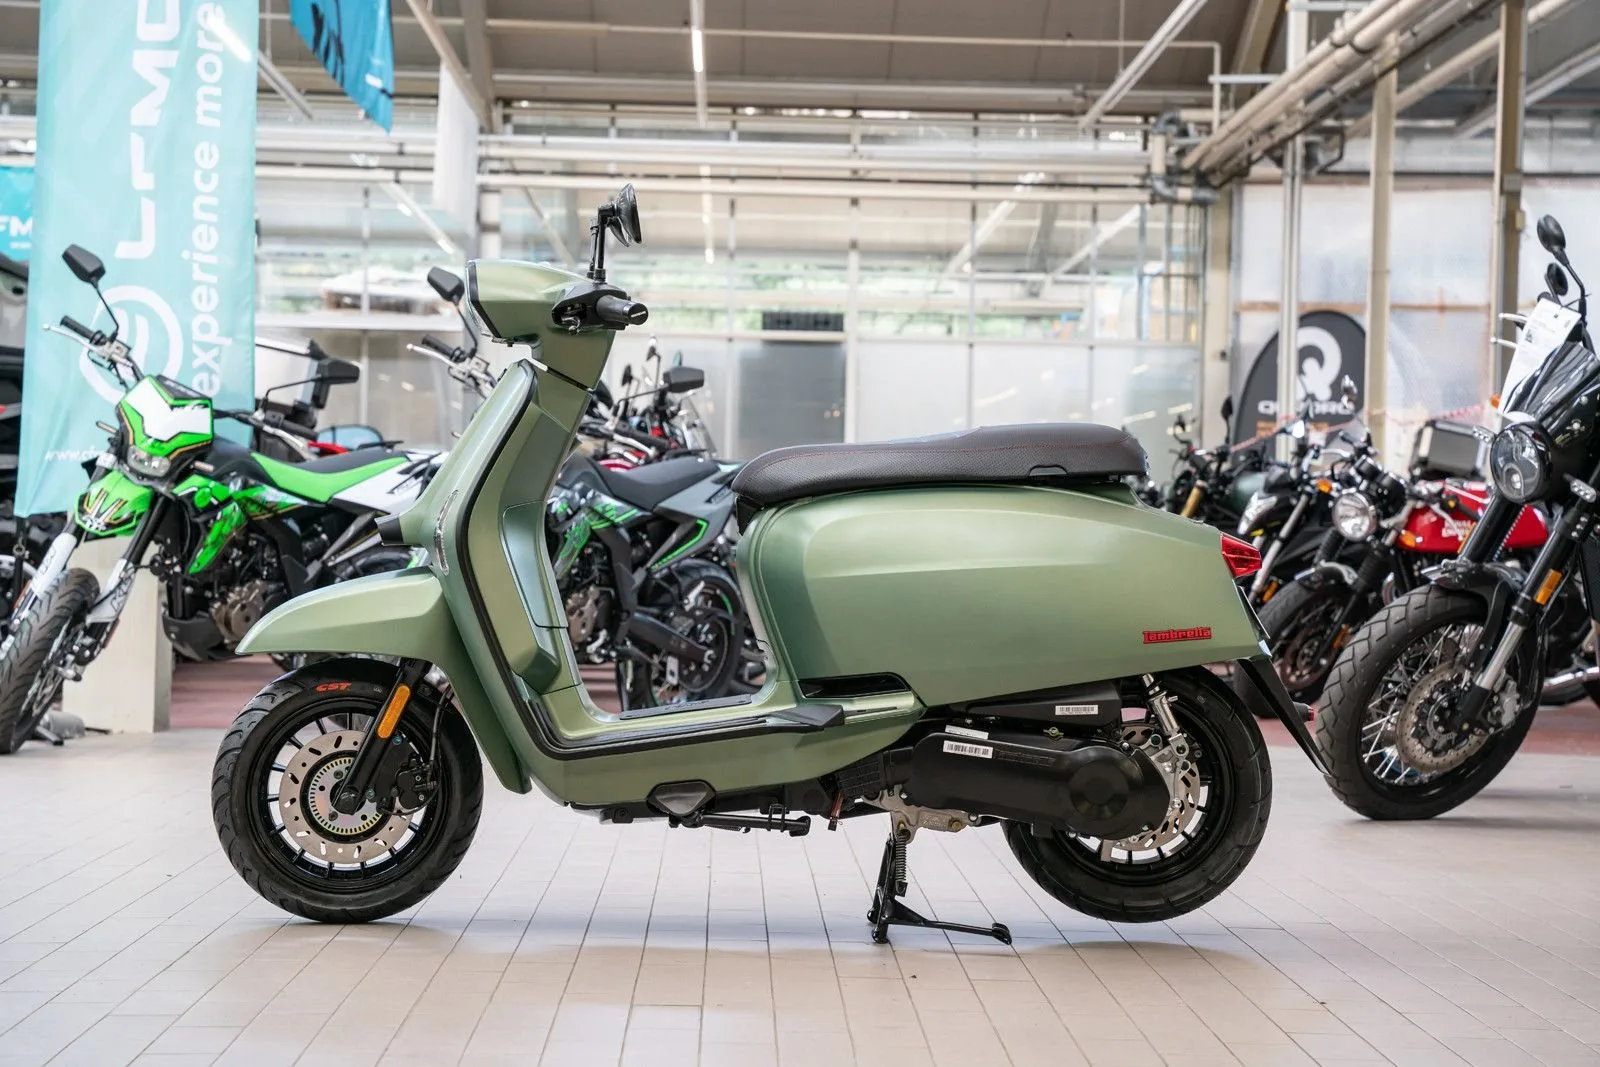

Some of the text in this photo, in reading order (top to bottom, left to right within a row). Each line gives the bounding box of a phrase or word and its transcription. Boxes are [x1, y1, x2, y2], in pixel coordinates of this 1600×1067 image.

[196, 3, 224, 127] more
[181, 141, 233, 397] experience
[315, 682, 352, 692] CST
